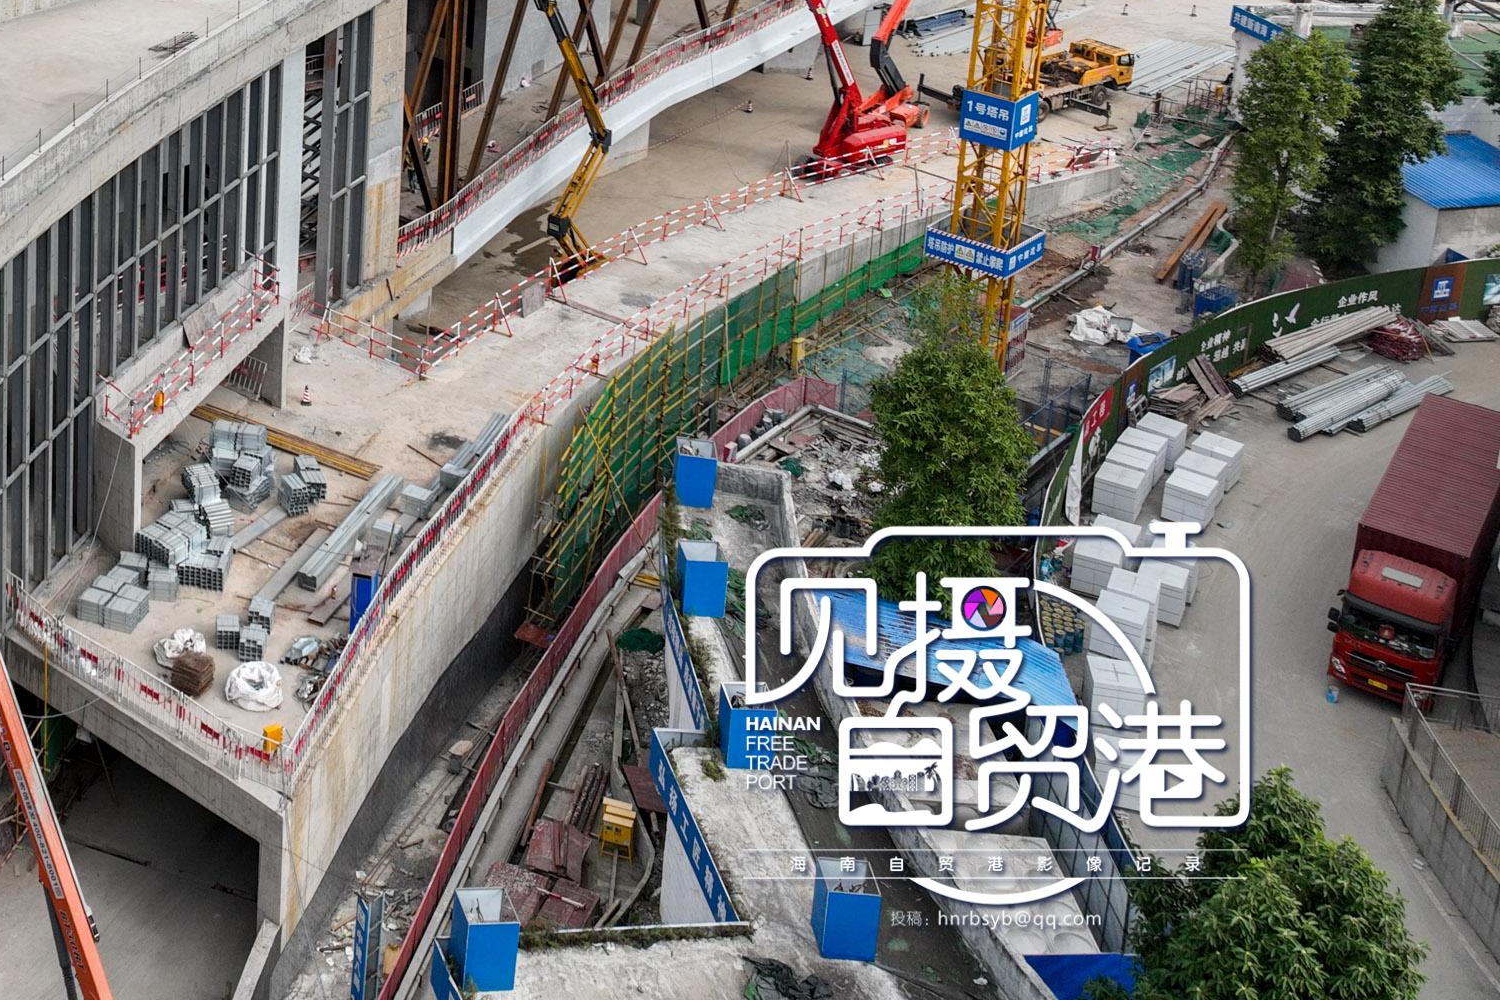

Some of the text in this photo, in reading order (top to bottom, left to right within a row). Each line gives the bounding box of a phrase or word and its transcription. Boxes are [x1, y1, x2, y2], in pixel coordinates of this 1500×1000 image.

[967, 100, 1009, 121] 1号塔吊
[1337, 290, 1379, 308] 企业作风
[1201, 329, 1232, 352] 企业精神
[658, 759, 727, 922] 弘扬工匠精神
